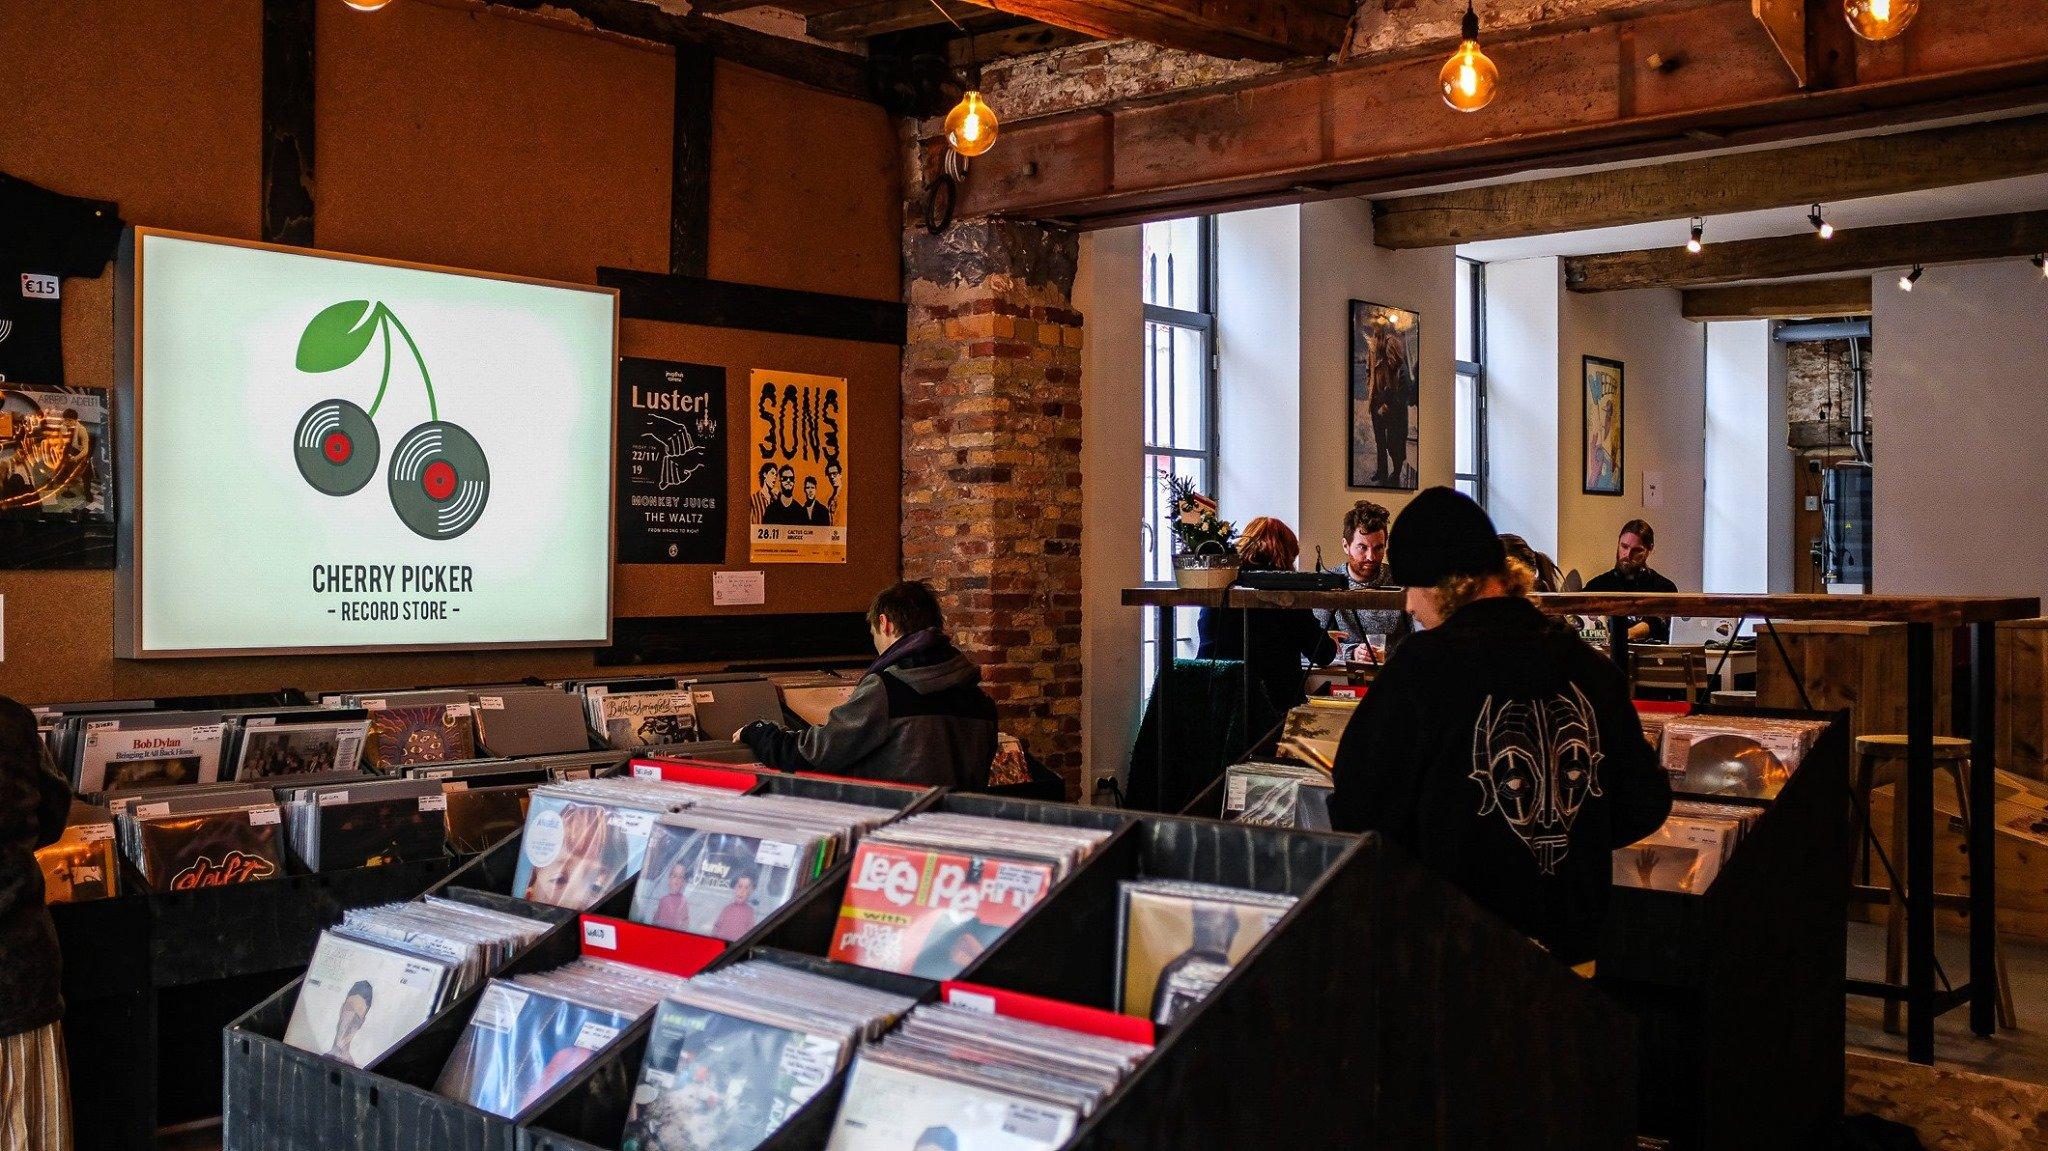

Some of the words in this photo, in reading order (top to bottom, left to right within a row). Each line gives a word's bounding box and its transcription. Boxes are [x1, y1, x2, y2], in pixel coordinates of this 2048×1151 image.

[25, 280, 55, 294] €15
[632, 385, 709, 413] Luster!
[758, 382, 840, 464] SONS
[632, 465, 643, 474] 19
[631, 495, 680, 507] MONKEY
[683, 497, 716, 509] JUICE
[645, 512, 665, 522] THE
[669, 513, 703, 523] WALTZ
[757, 528, 779, 540] 28.11
[312, 564, 396, 593] CHERRY
[402, 564, 473, 593] PICKER
[341, 601, 399, 621] RECORD
[403, 601, 447, 620] STORE
[132, 739, 151, 750] Bob
[153, 738, 181, 749] Dylan
[116, 751, 144, 760] Bringing
[159, 749, 175, 757] Back
[175, 748, 194, 756] Home
